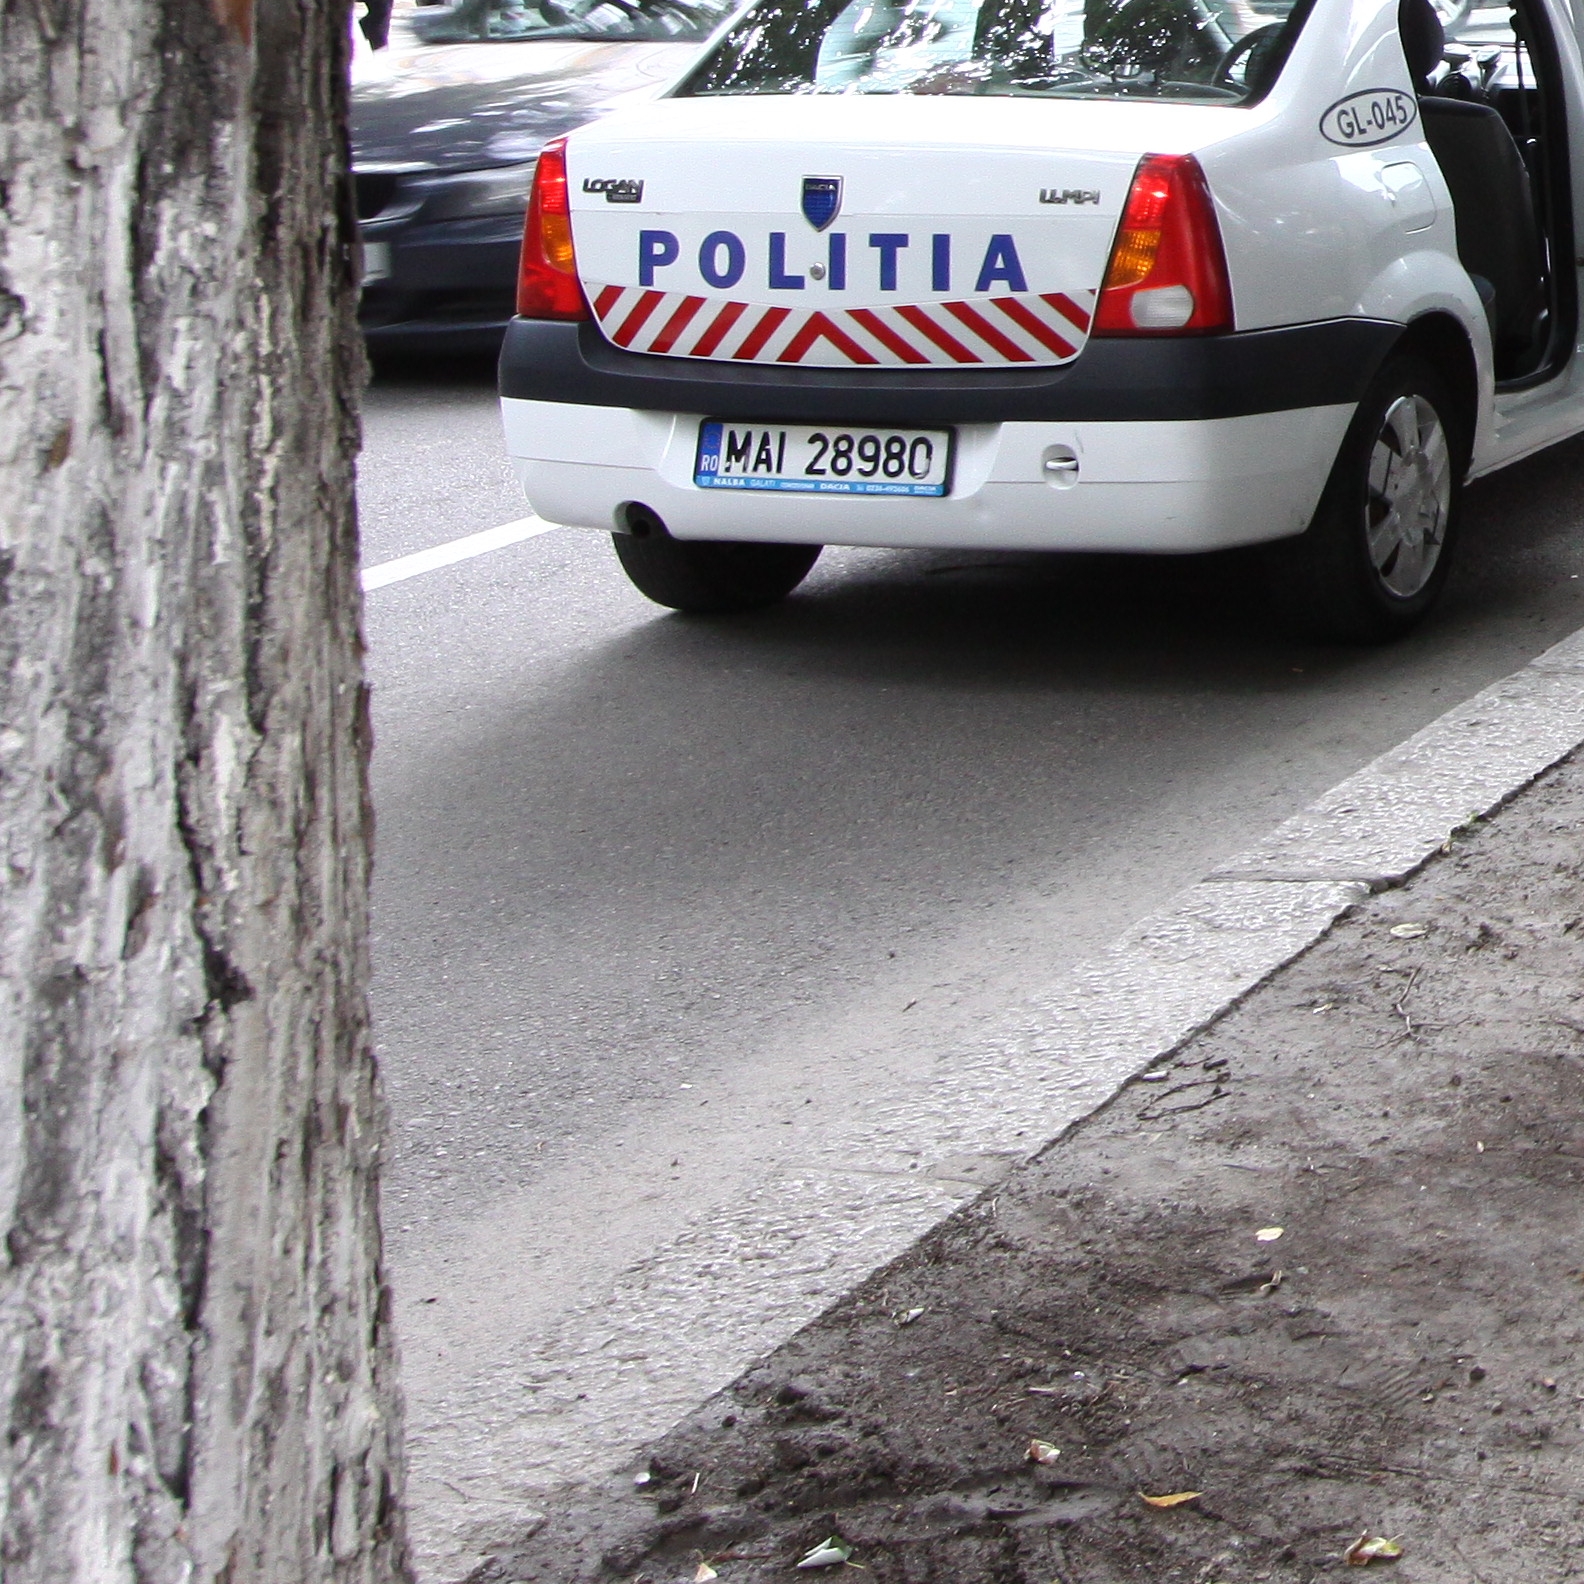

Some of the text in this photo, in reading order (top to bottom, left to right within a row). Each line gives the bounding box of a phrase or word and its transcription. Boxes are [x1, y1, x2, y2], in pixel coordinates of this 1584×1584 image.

[1337, 95, 1407, 139] GL-045
[583, 178, 645, 195] LOGAN
[639, 230, 1028, 292] POLITIA
[701, 455, 719, 471] RO
[725, 429, 933, 480] MAI 28980
[713, 478, 746, 487] NALBA
[820, 483, 850, 491] DACIA
